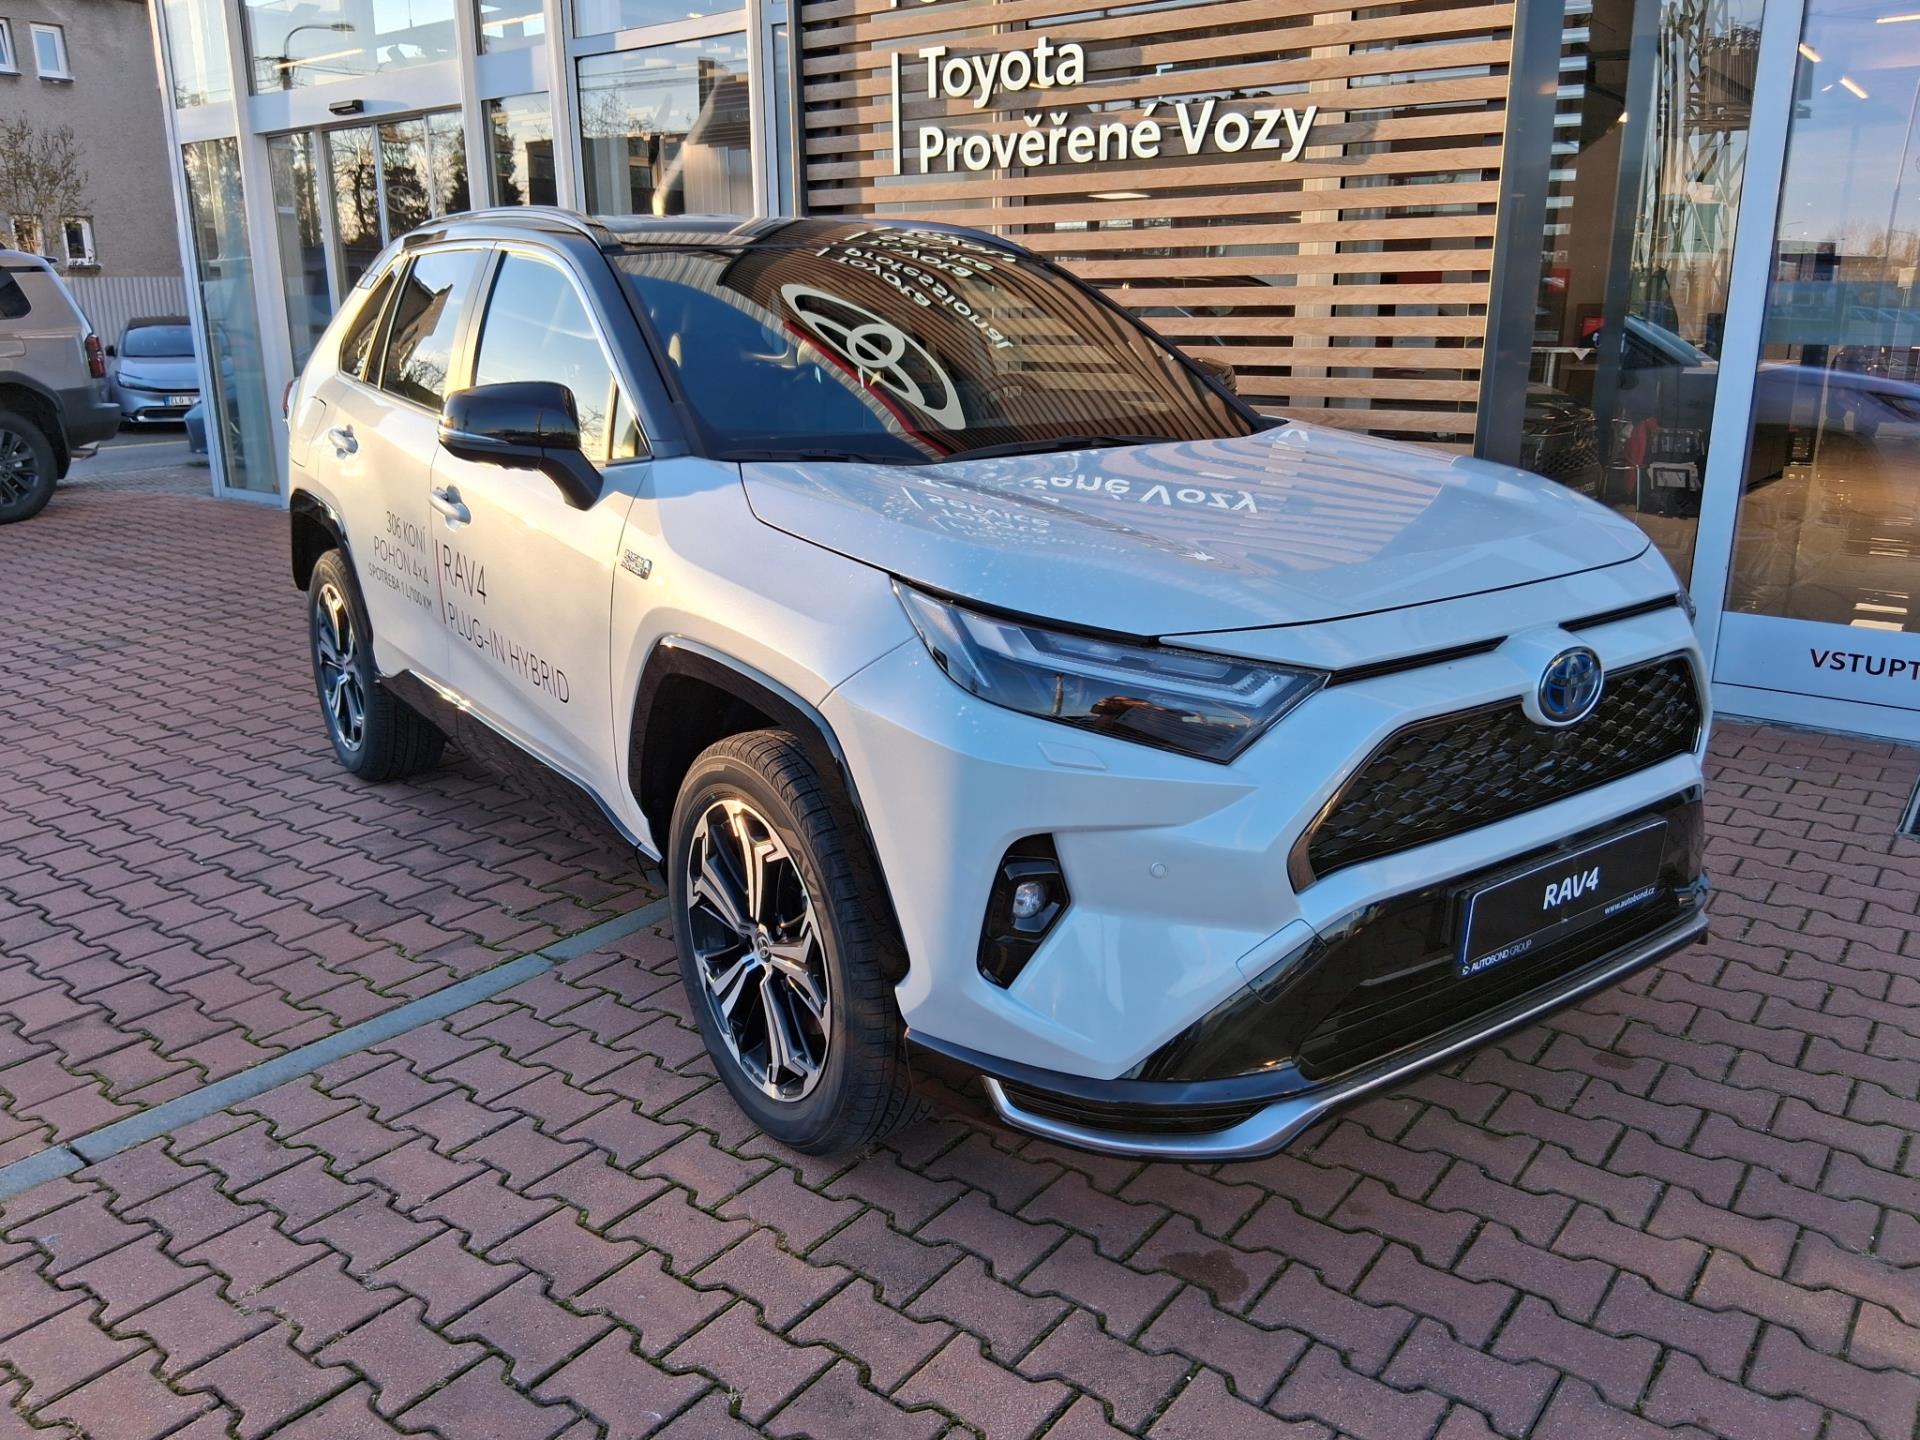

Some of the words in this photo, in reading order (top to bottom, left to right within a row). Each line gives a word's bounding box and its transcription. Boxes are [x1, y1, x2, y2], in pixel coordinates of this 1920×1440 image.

[919, 36, 1085, 109] Toyota
[919, 102, 1162, 174] Prověřené
[1175, 99, 1319, 162] Vozy
[374, 535, 411, 576] POHON
[386, 510, 402, 539] 306
[403, 520, 426, 555] KONÍ
[443, 544, 487, 605] RAV4
[448, 602, 506, 665] PLUG-IN
[508, 639, 570, 703] HYBRID
[1543, 866, 1599, 910] RAV4
[1471, 949, 1509, 972] AUTOBOND
[1510, 939, 1532, 956] GROUP
